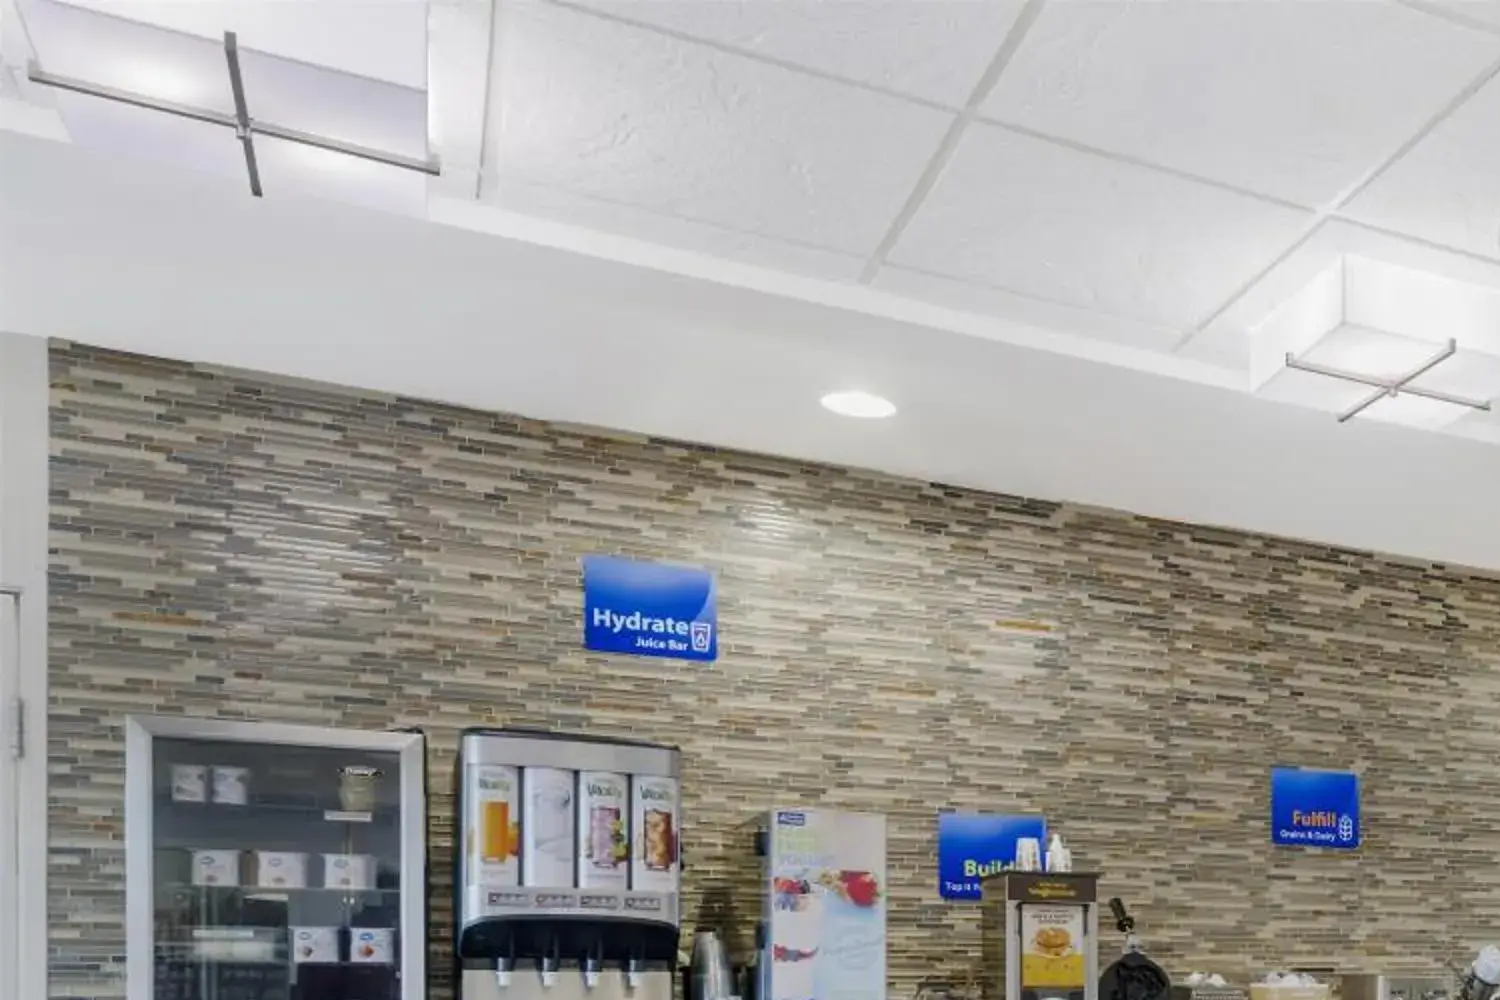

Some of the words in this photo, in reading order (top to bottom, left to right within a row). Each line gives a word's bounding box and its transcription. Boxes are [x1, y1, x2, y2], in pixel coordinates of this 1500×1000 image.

[593, 608, 689, 633] Hydrate
[636, 636, 665, 649] Juice
[668, 640, 689, 651] Bar
[1293, 810, 1337, 828] Fulfill
